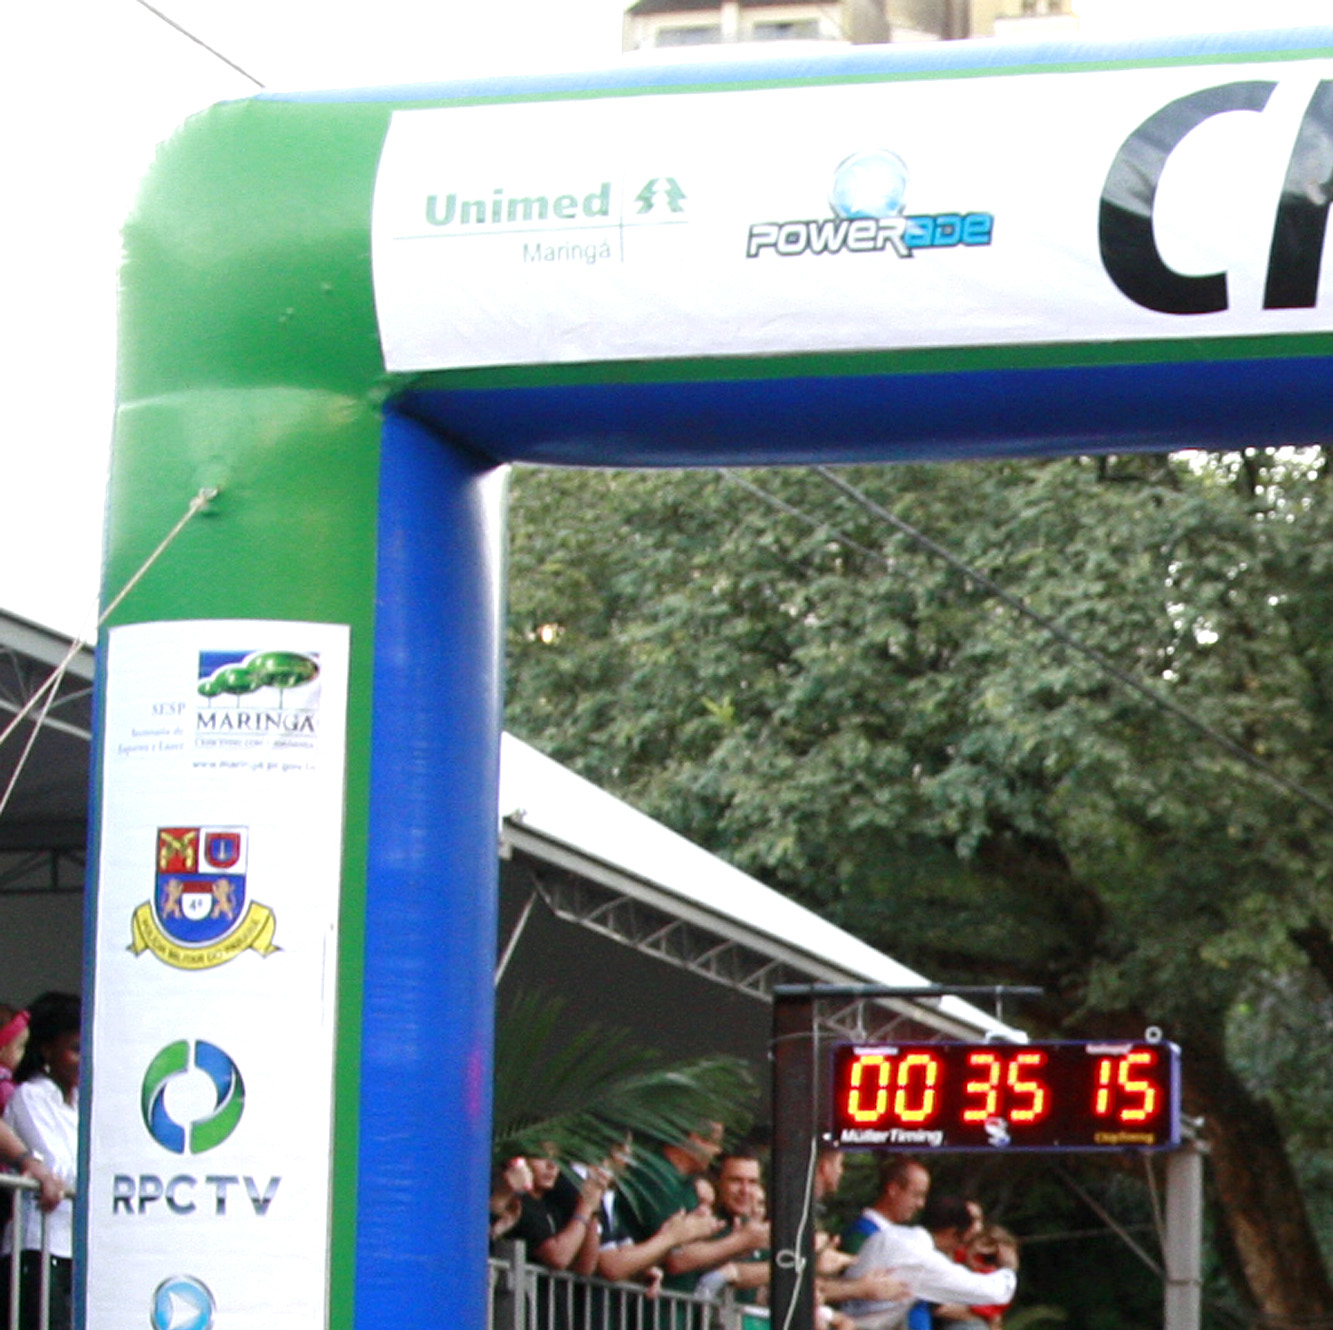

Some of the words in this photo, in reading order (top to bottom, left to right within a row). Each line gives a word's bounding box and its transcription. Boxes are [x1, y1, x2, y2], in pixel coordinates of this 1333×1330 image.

[424, 182, 611, 227] Unimed
[522, 237, 612, 266] Maringá
[746, 212, 994, 258] POWERADE
[847, 1054, 938, 1122] 00
[963, 1053, 1045, 1121] 35
[1096, 1053, 1156, 1120] 15
